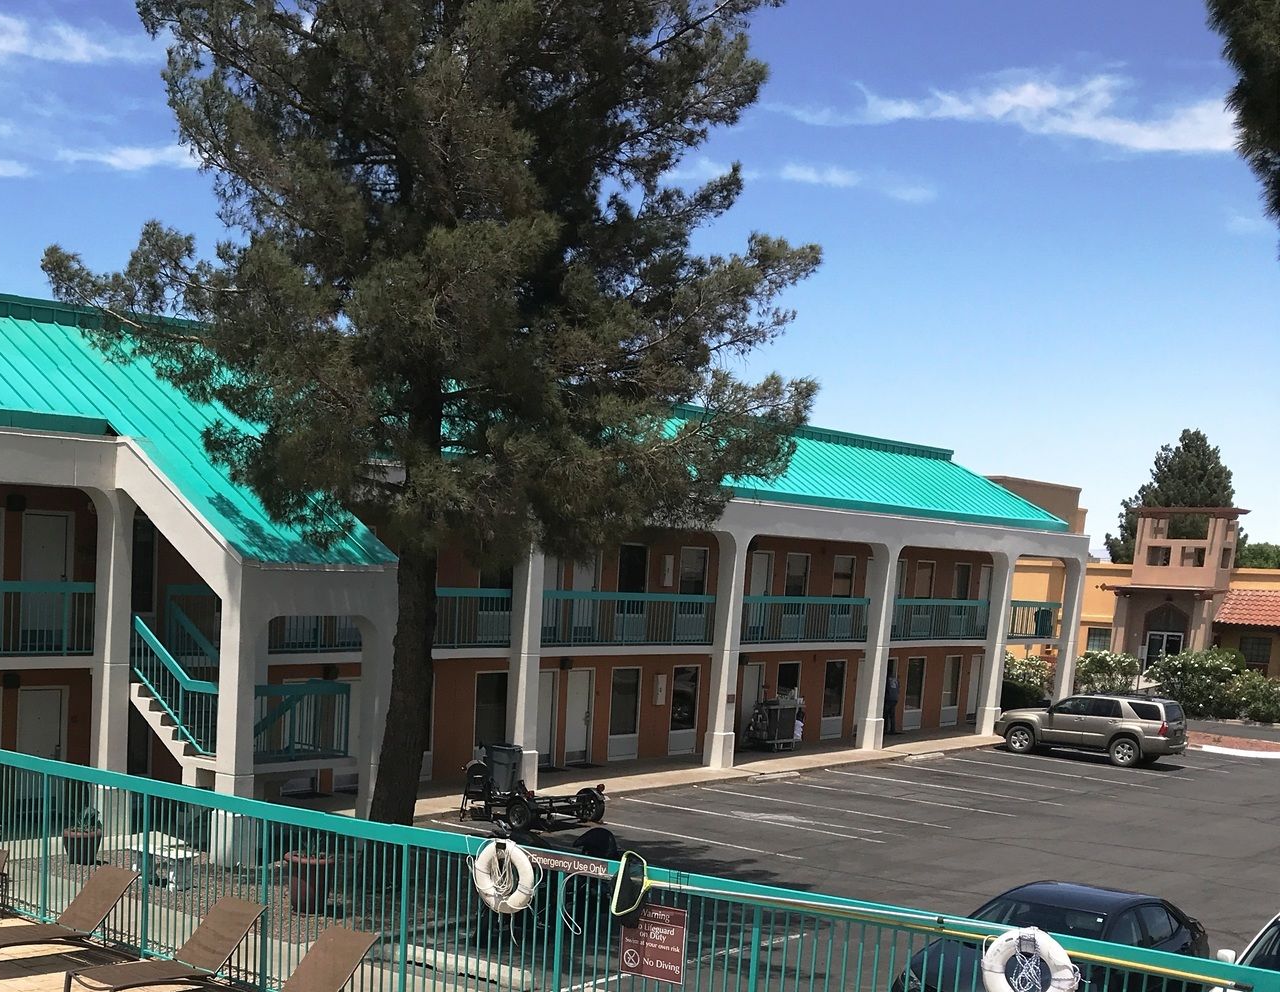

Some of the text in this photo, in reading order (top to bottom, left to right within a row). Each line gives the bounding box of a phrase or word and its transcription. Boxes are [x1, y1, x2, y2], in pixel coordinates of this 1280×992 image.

[531, 853, 607, 874] Emergency Use Only
[644, 923, 675, 936] Lifeguard
[649, 931, 667, 943] Duty
[646, 941, 657, 949] your
[643, 957, 680, 974] No Diving
